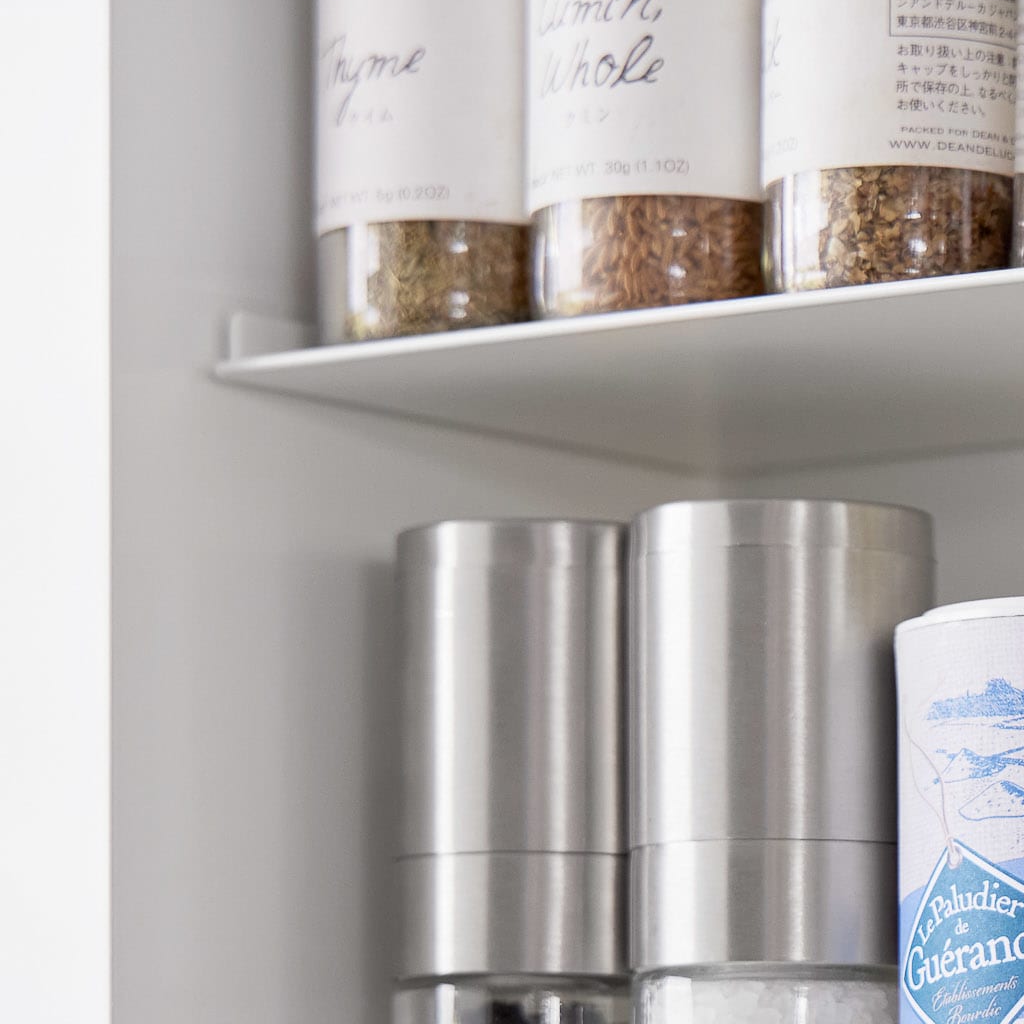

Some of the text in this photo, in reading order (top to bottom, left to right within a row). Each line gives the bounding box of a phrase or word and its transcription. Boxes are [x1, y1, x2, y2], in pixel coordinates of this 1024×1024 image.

[321, 32, 426, 128] Thyme
[541, 34, 664, 99] Whole
[900, 126, 944, 135] PACKED
[917, 880, 1024, 945] Le Paludier
[955, 918, 970, 935] de
